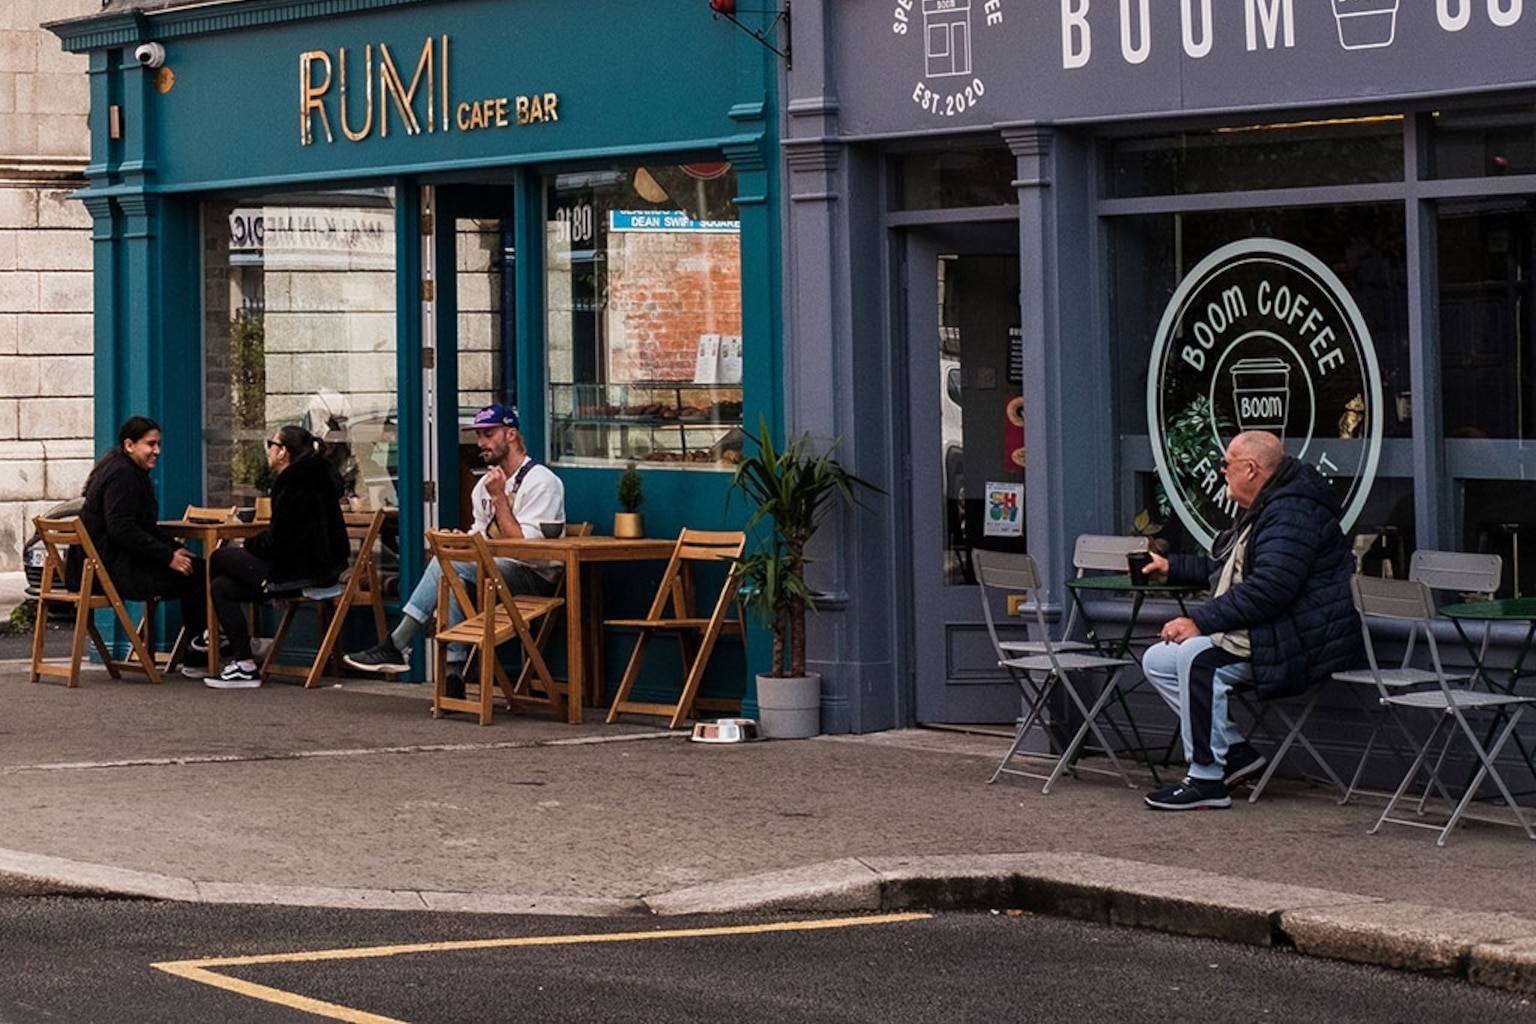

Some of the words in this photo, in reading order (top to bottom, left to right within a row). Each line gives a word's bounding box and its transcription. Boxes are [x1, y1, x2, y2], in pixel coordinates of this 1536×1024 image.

[299, 34, 449, 146] RUMI
[456, 97, 509, 131] CAFE
[516, 91, 559, 126] BAR
[630, 216, 660, 228] DEAN
[1180, 284, 1248, 372] BOOM
[1257, 279, 1346, 376] COFFEE
[1240, 395, 1283, 418] BOOM
